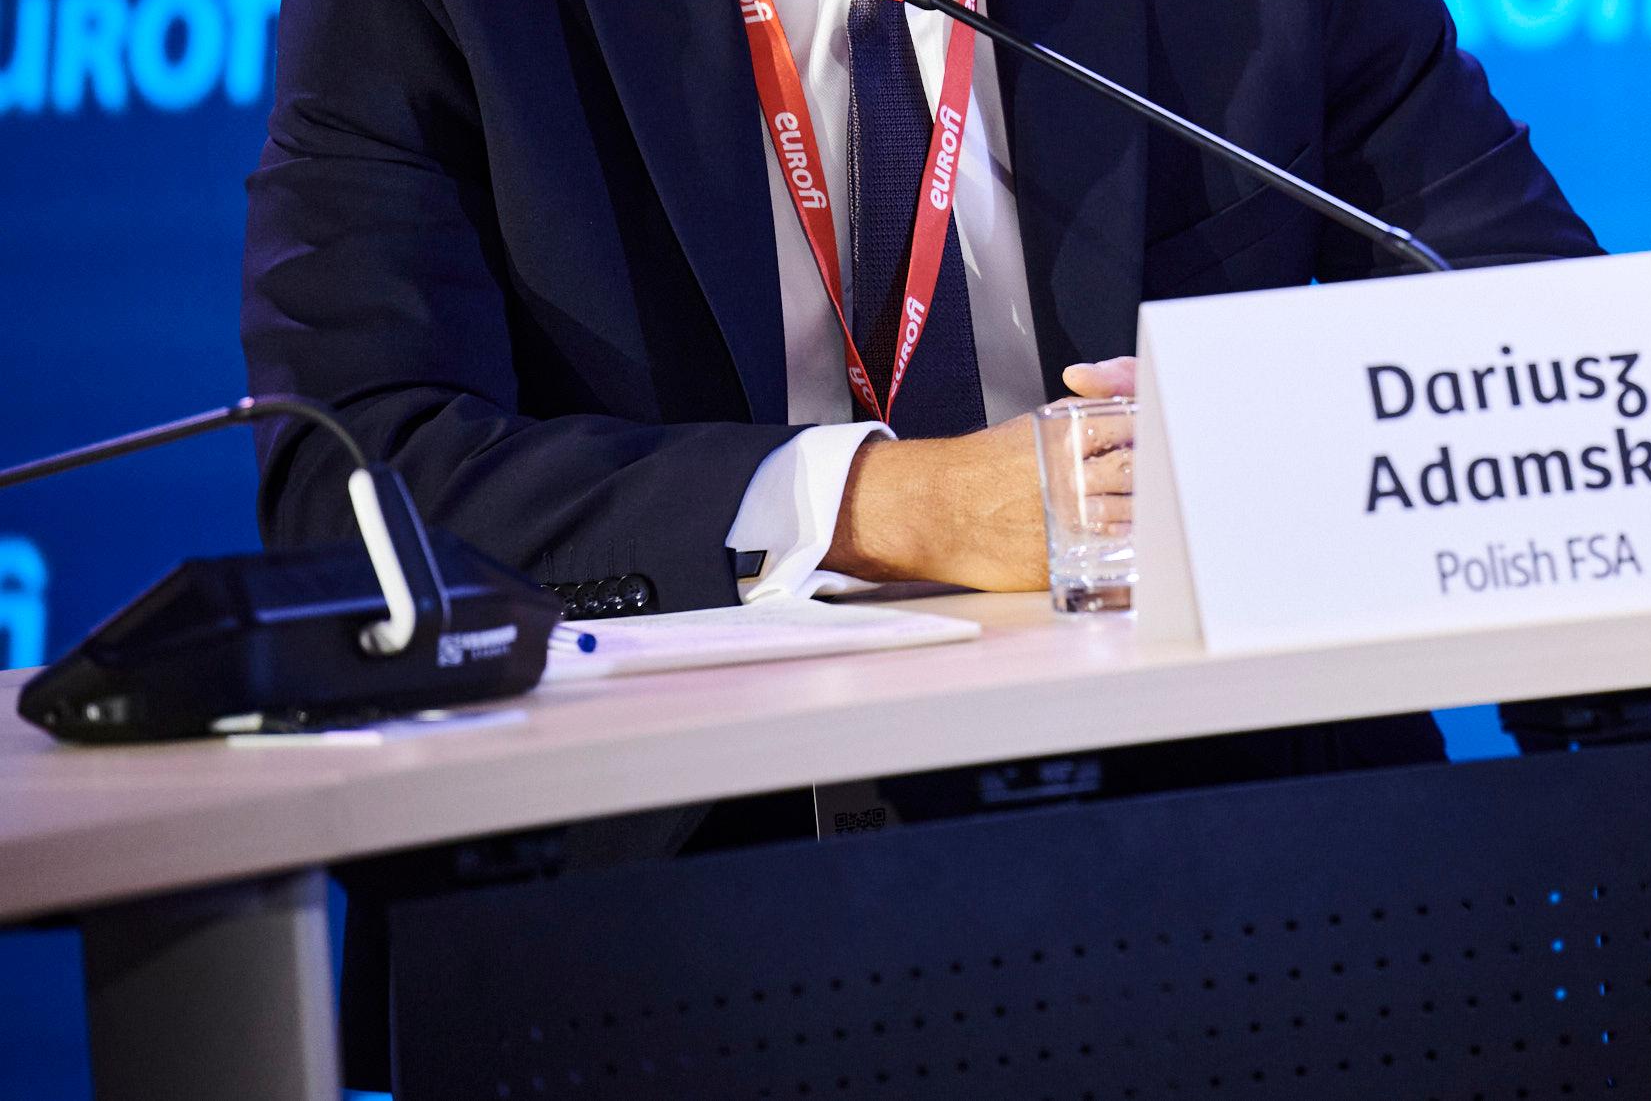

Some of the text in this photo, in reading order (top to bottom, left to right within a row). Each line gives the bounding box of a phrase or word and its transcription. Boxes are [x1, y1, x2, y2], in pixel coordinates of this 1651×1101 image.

[1366, 345, 1648, 419] Dariusz
[1436, 533, 1643, 594] Polish FSA
